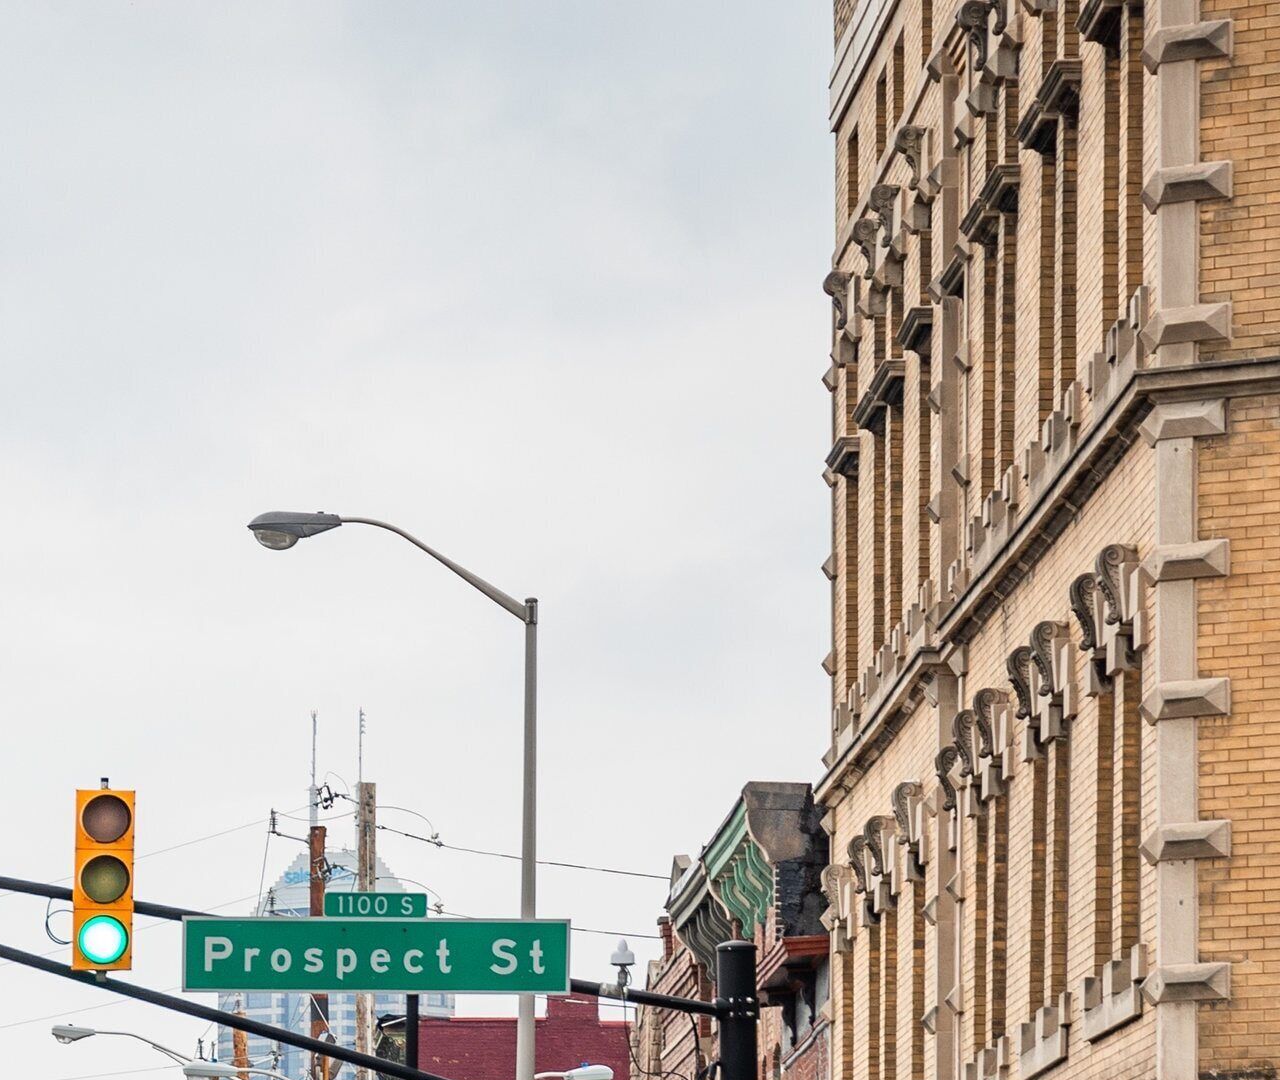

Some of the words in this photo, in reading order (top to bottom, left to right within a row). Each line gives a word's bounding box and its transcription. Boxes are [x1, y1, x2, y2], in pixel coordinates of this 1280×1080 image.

[338, 895, 388, 915] 1100
[401, 896, 413, 915] S
[204, 936, 452, 980] Prospect
[489, 938, 545, 976] St
